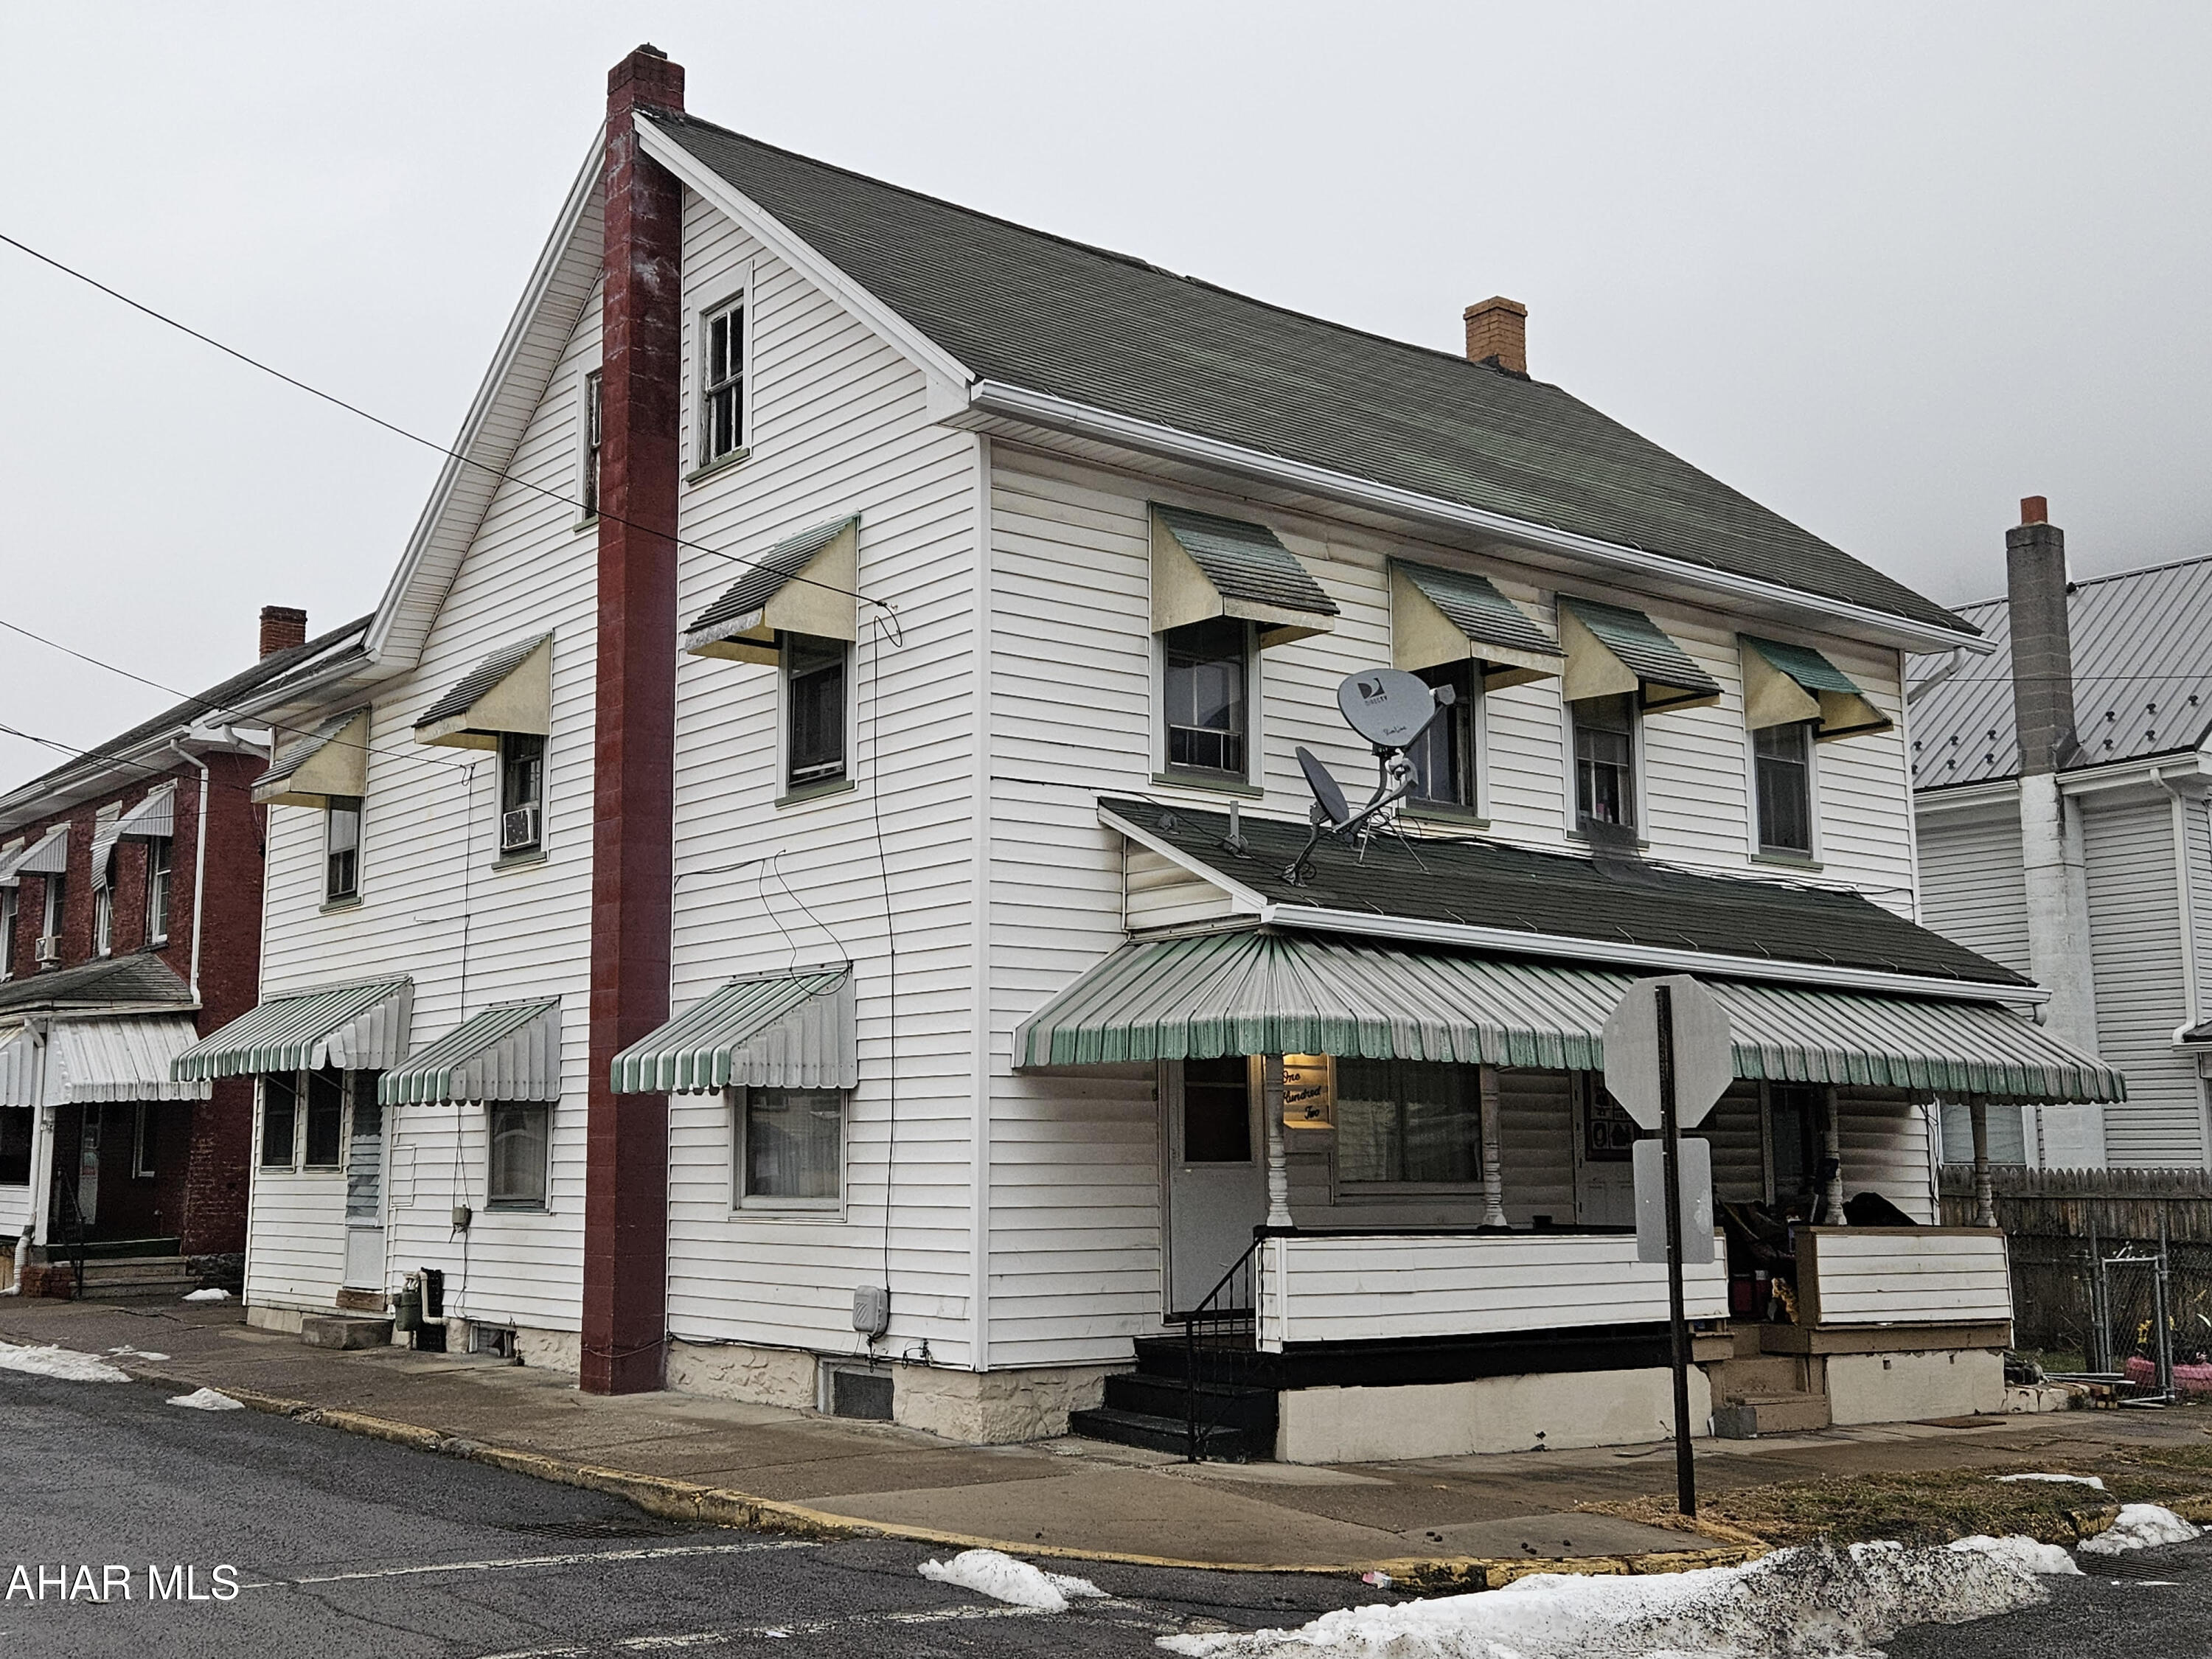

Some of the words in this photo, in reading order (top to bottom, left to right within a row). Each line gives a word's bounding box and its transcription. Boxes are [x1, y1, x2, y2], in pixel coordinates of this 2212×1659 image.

[1282, 1070, 1301, 1084] One
[1283, 1085, 1322, 1104] Hundred
[1304, 1105, 1321, 1120] Two
